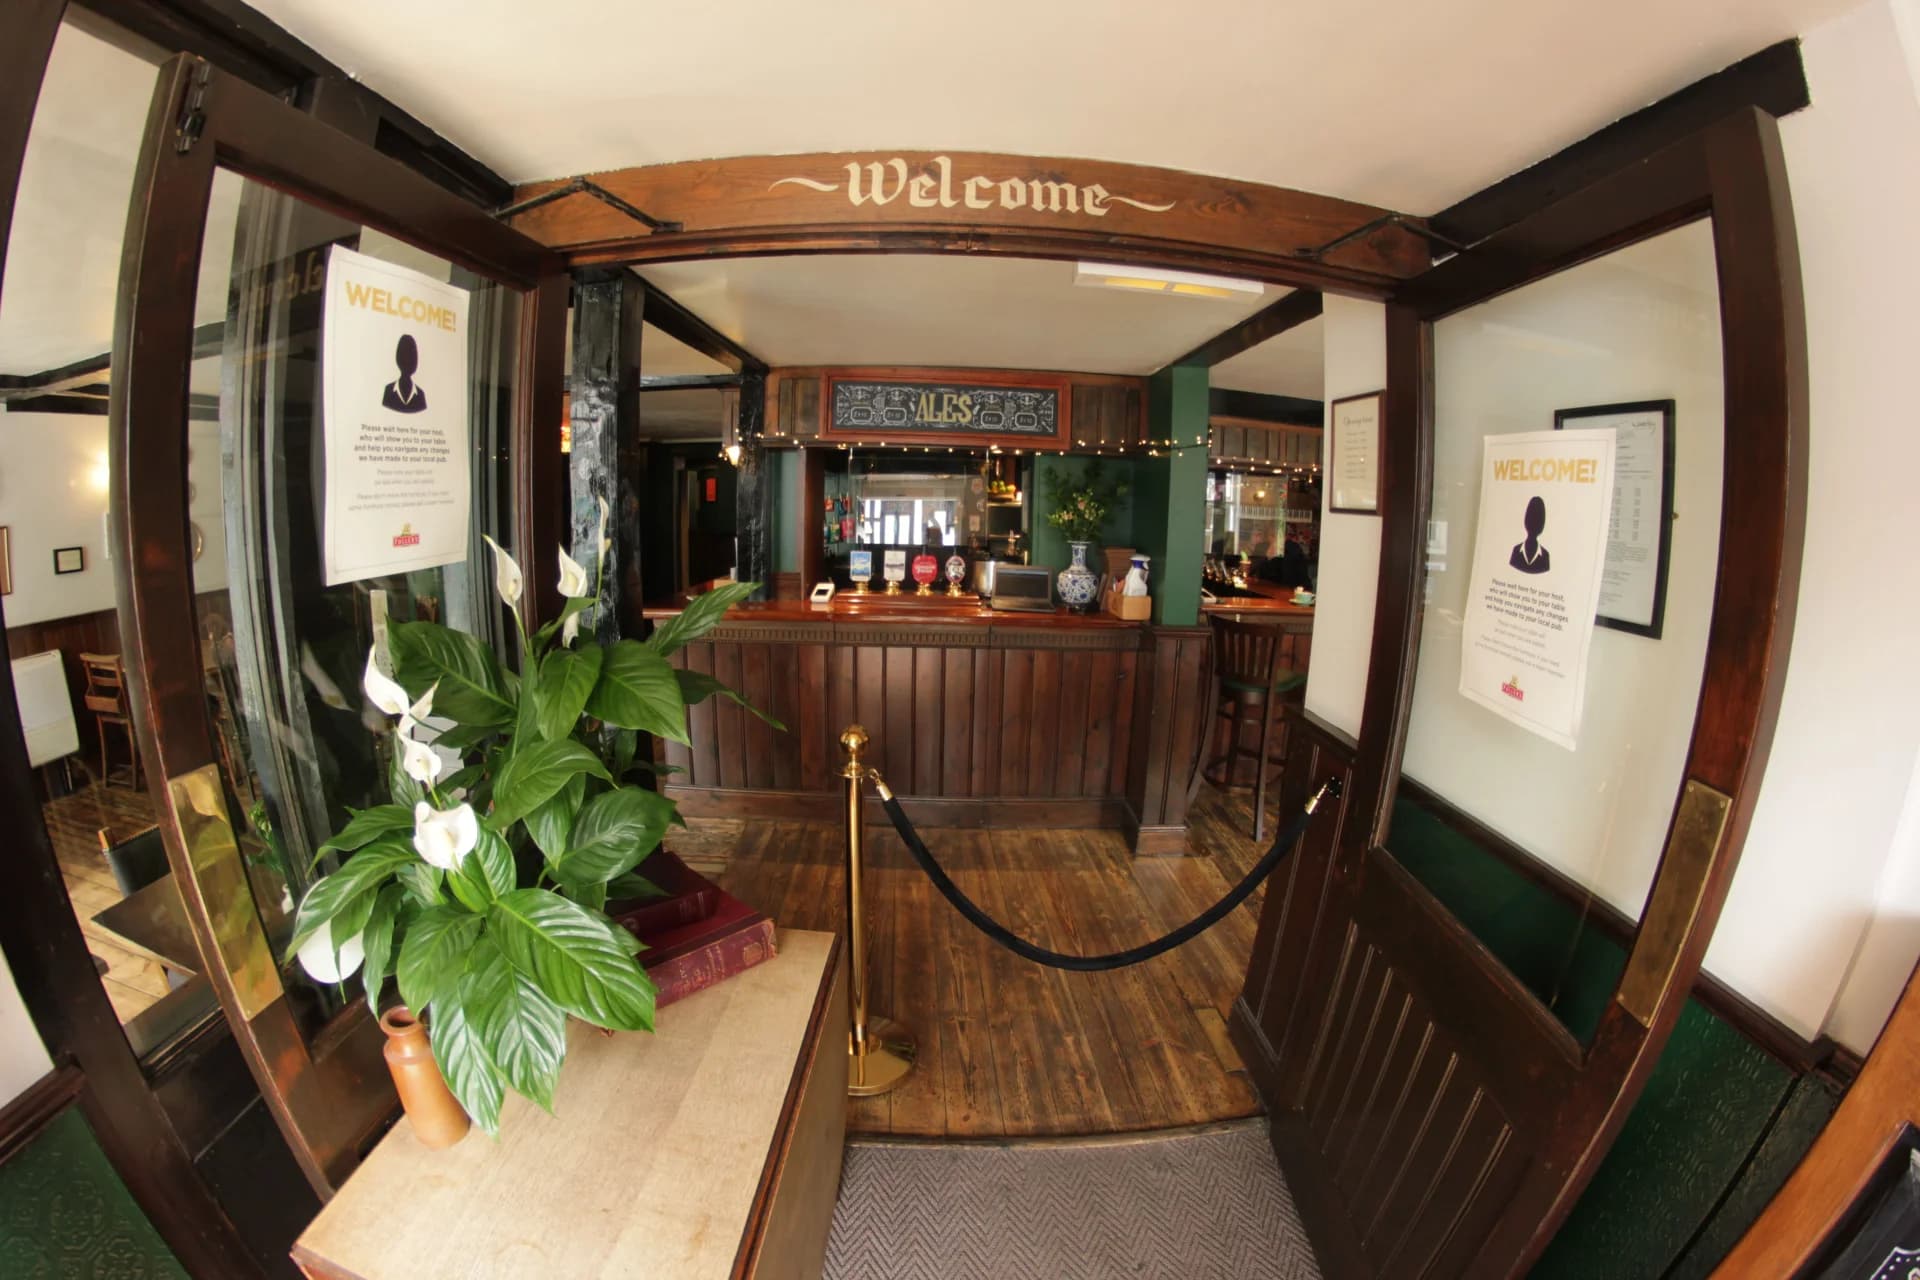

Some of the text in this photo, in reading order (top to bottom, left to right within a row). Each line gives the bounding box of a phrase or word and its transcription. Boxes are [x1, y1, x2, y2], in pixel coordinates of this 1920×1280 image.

[843, 155, 1113, 217] Welcome
[345, 280, 456, 333] WELCOME!
[914, 391, 973, 424] ALES
[360, 434, 372, 442] who
[386, 435, 401, 443] show
[367, 444, 381, 453] help
[382, 446, 394, 454] you
[1493, 458, 1598, 484] WELCOME!
[1521, 595, 1531, 603] you
[1538, 599, 1550, 607] your
[1551, 602, 1565, 611] table
[1538, 590, 1551, 598] your
[1504, 600, 1513, 608] you
[1535, 608, 1545, 616] any
[1546, 610, 1568, 622] changes
[1525, 615, 1537, 623] your
[1537, 617, 1550, 627] local
